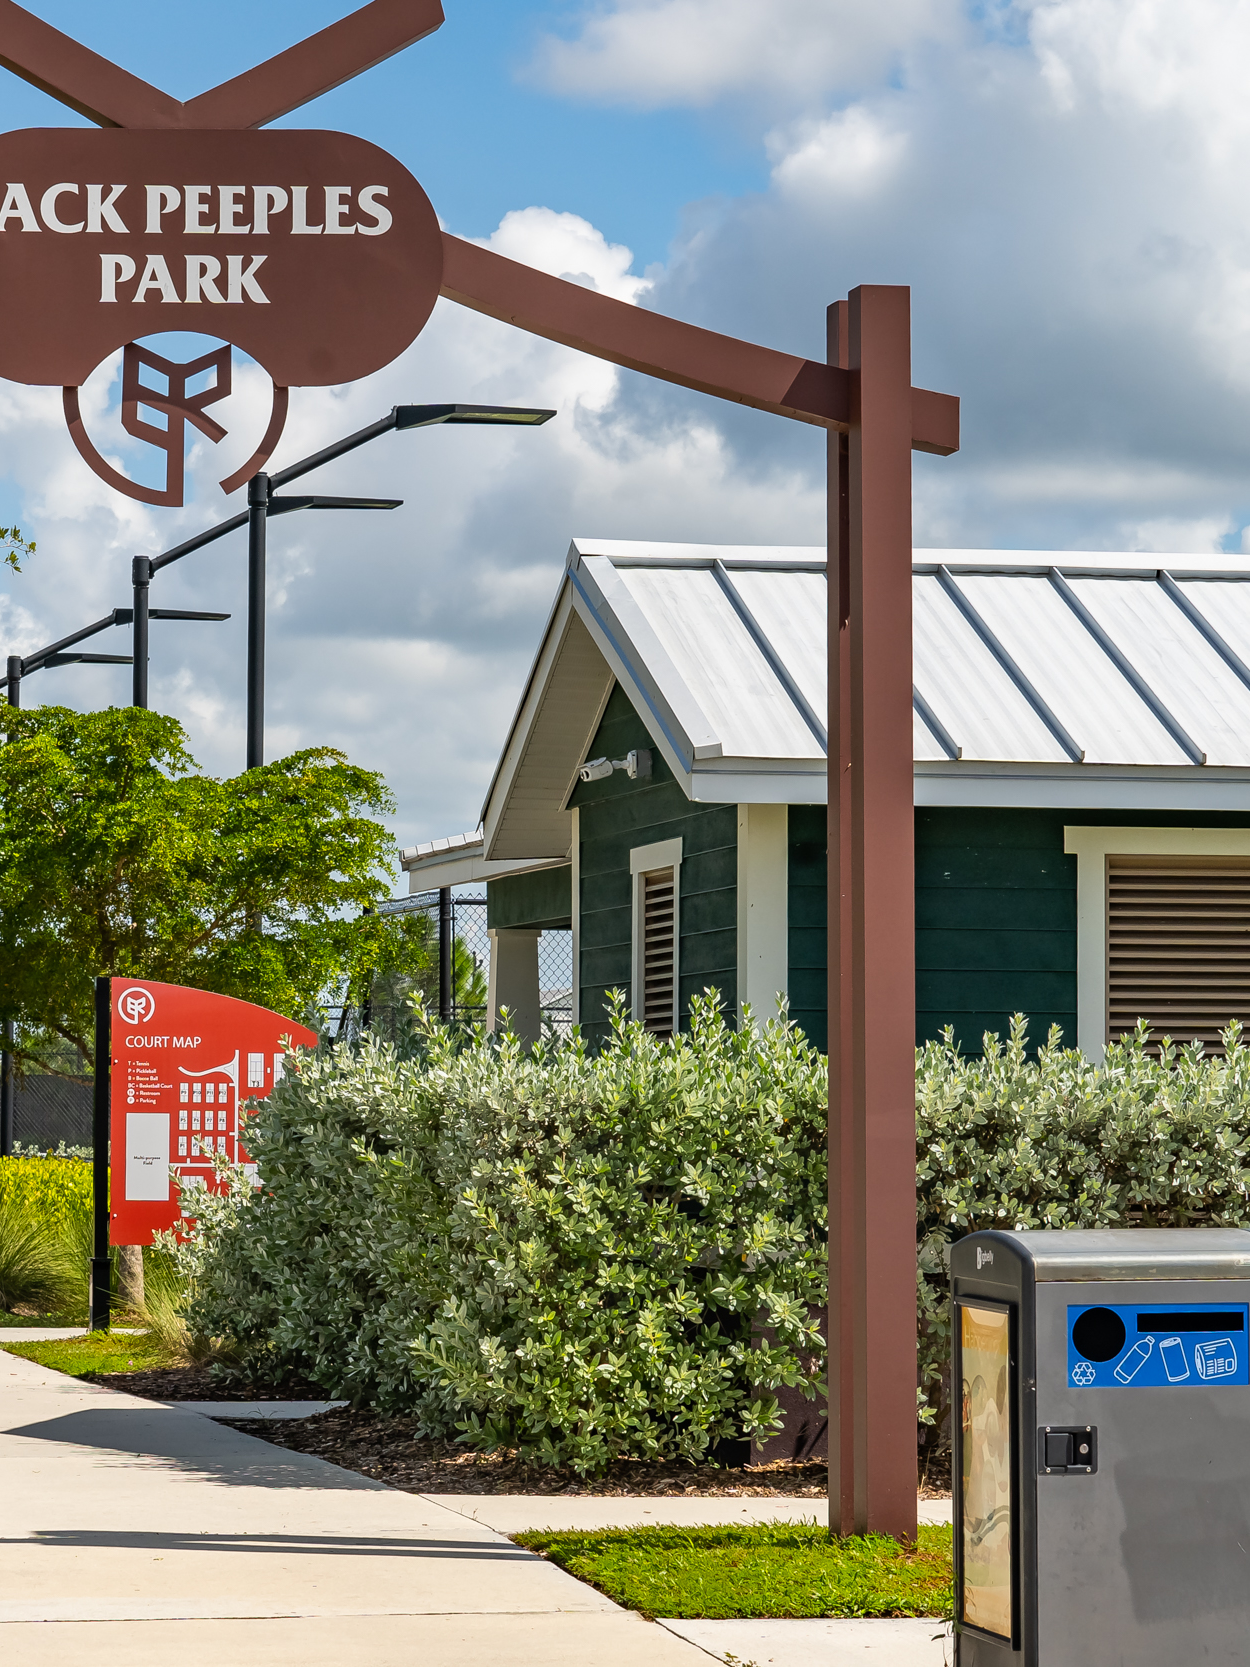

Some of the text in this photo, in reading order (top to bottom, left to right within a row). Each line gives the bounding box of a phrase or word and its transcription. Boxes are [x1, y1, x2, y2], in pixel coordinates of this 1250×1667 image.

[144, 185, 393, 236] PEEPLES
[99, 254, 271, 304] PARK
[125, 1036, 202, 1048] COURT MAP
